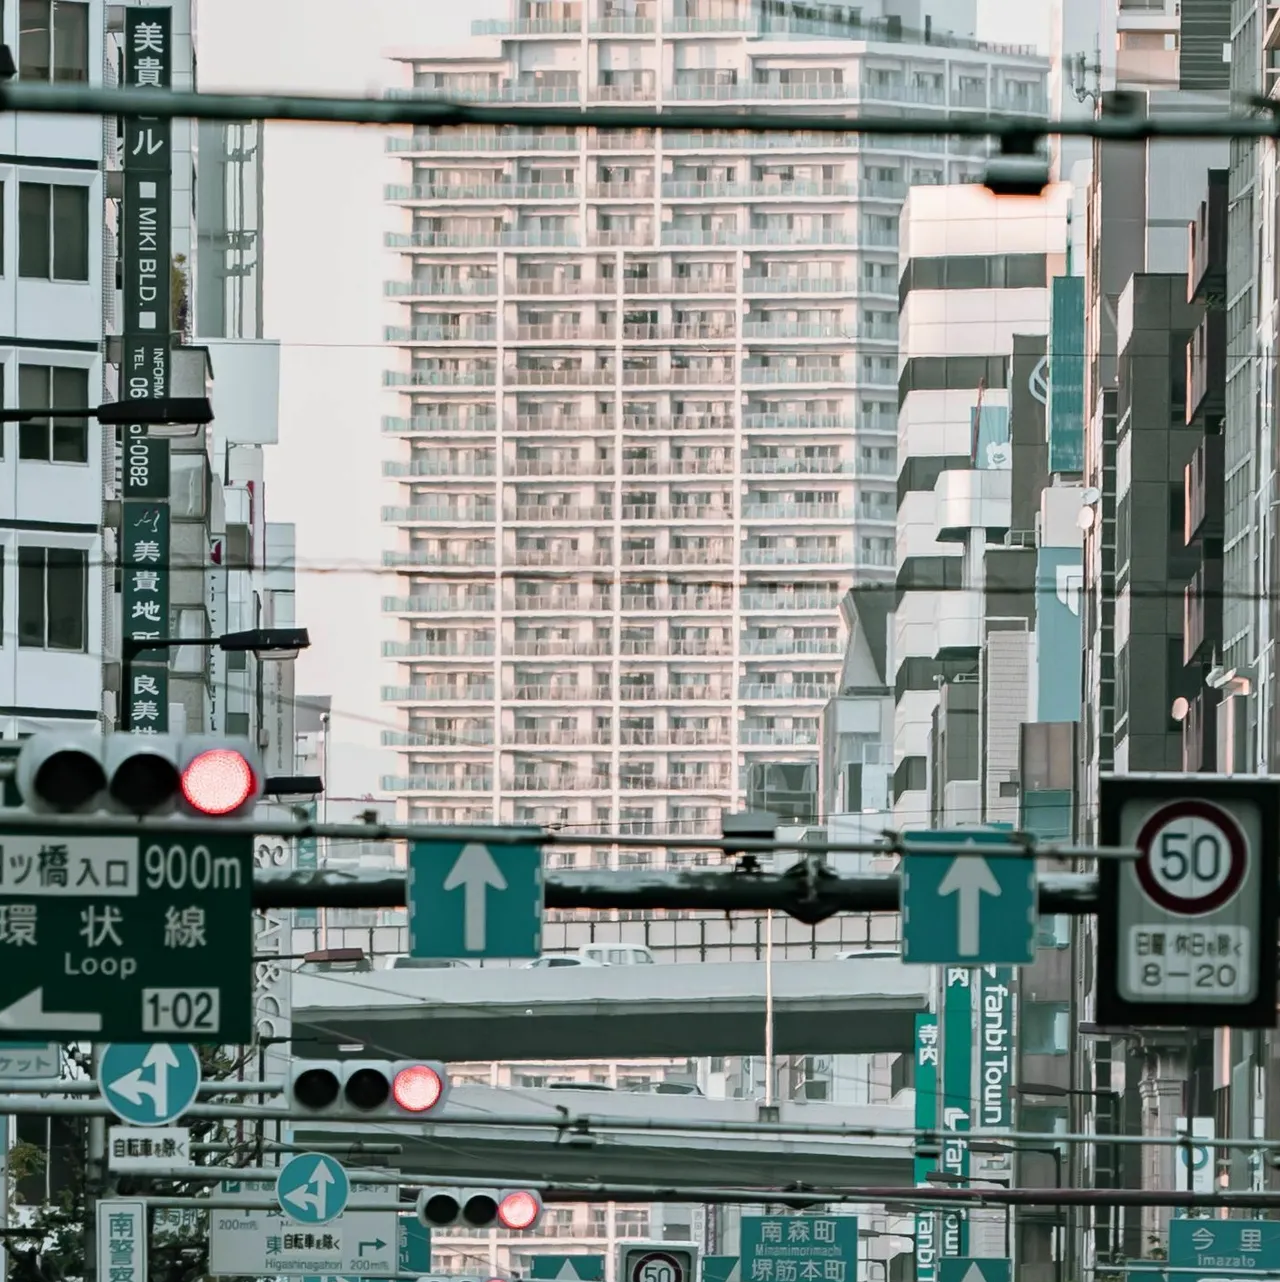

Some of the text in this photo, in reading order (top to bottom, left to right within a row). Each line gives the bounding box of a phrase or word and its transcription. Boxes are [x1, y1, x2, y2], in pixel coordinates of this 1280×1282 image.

[132, 21, 164, 156] 美貴ル
[139, 207, 157, 306] MIKI BLD.
[134, 347, 144, 371] TEL
[153, 347, 165, 398] INFORM
[132, 540, 162, 652] 美貴地所
[145, 845, 241, 890] 900m
[1160, 832, 1221, 882] 50
[65, 952, 137, 979] Loop
[148, 991, 214, 1028] 1-02
[985, 983, 1008, 1125] fanbi Town
[113, 1137, 185, 1158] 自転車を除く
[283, 1233, 340, 1251] 自転車を除く
[761, 1221, 837, 1243] 南森町
[1192, 1227, 1262, 1252] 今里
[755, 1244, 842, 1257] Minamimorimachi
[751, 1259, 847, 1282] 堺筋本町
